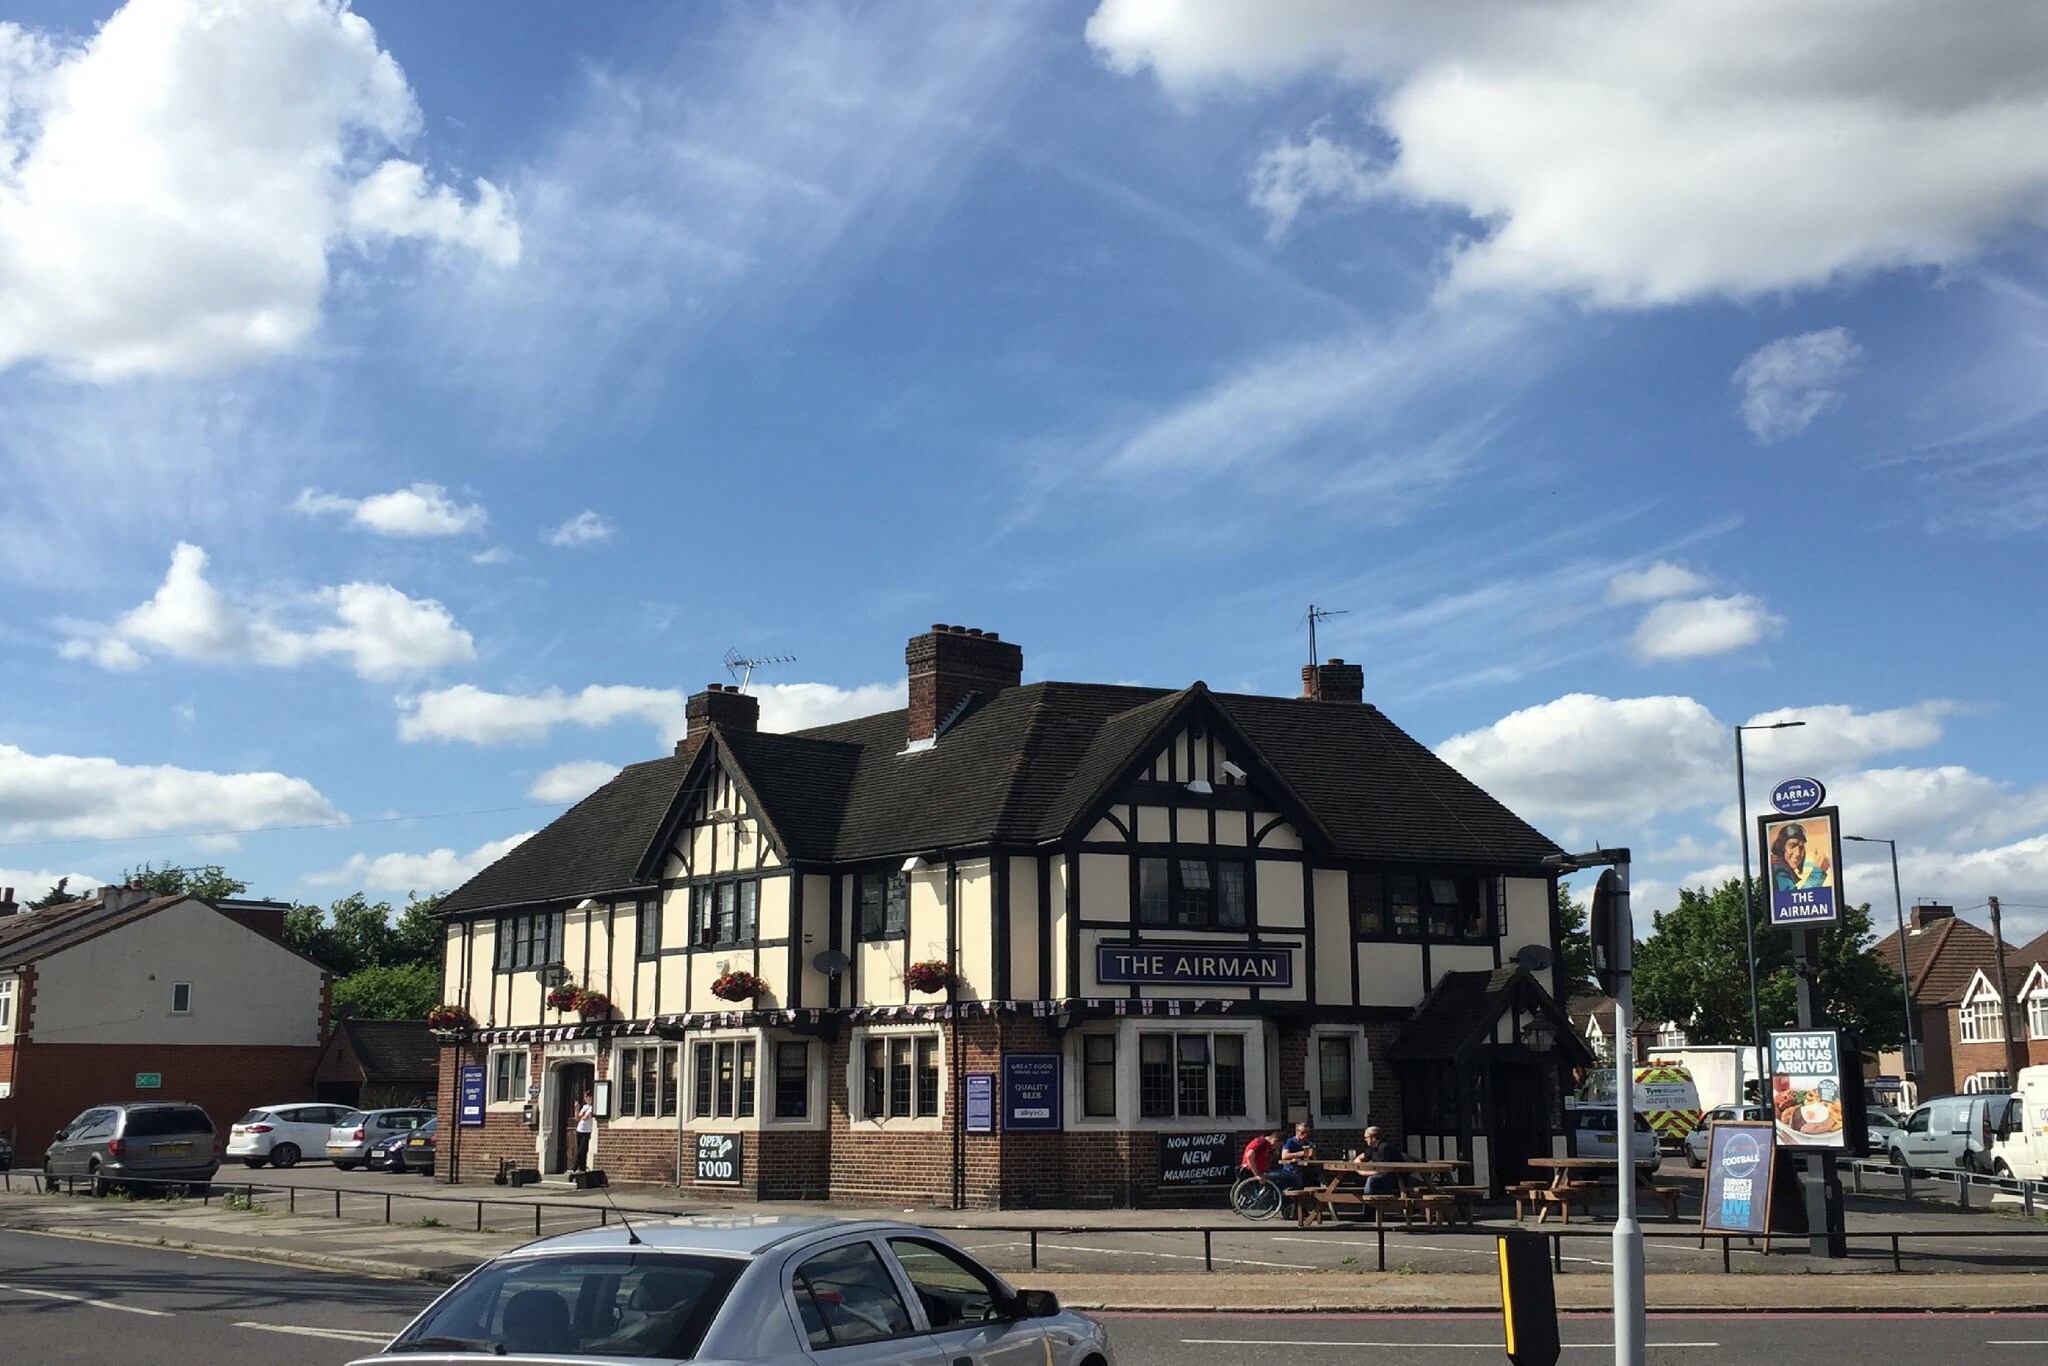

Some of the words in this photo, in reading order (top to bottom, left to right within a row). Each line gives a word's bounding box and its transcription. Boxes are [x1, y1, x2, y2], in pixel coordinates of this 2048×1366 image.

[1775, 787, 1816, 802] BARRAS
[1791, 891, 1814, 904] THE
[1779, 903, 1828, 918] AIRMAN
[1115, 955, 1164, 976] THE
[1174, 957, 1277, 977] AIRMAN
[1775, 1037, 1801, 1049] OUR
[1802, 1036, 1831, 1049] NEW
[1775, 1049, 1806, 1061] MENU
[1807, 1049, 1832, 1061] HAS
[1776, 1061, 1833, 1073] ARRIVED
[1014, 1083, 1049, 1092] QUALITY
[1022, 1091, 1042, 1099] BEER
[699, 1134, 724, 1147] OPEN
[1167, 1137, 1190, 1148] NOW
[1192, 1133, 1227, 1146] UNDER
[1181, 1150, 1211, 1165] NEW
[1722, 1154, 1760, 1166] FOOTBALL
[698, 1160, 733, 1178] FOOD
[1163, 1165, 1229, 1181] MANAGEMENT
[1722, 1200, 1750, 1216] LIVE
